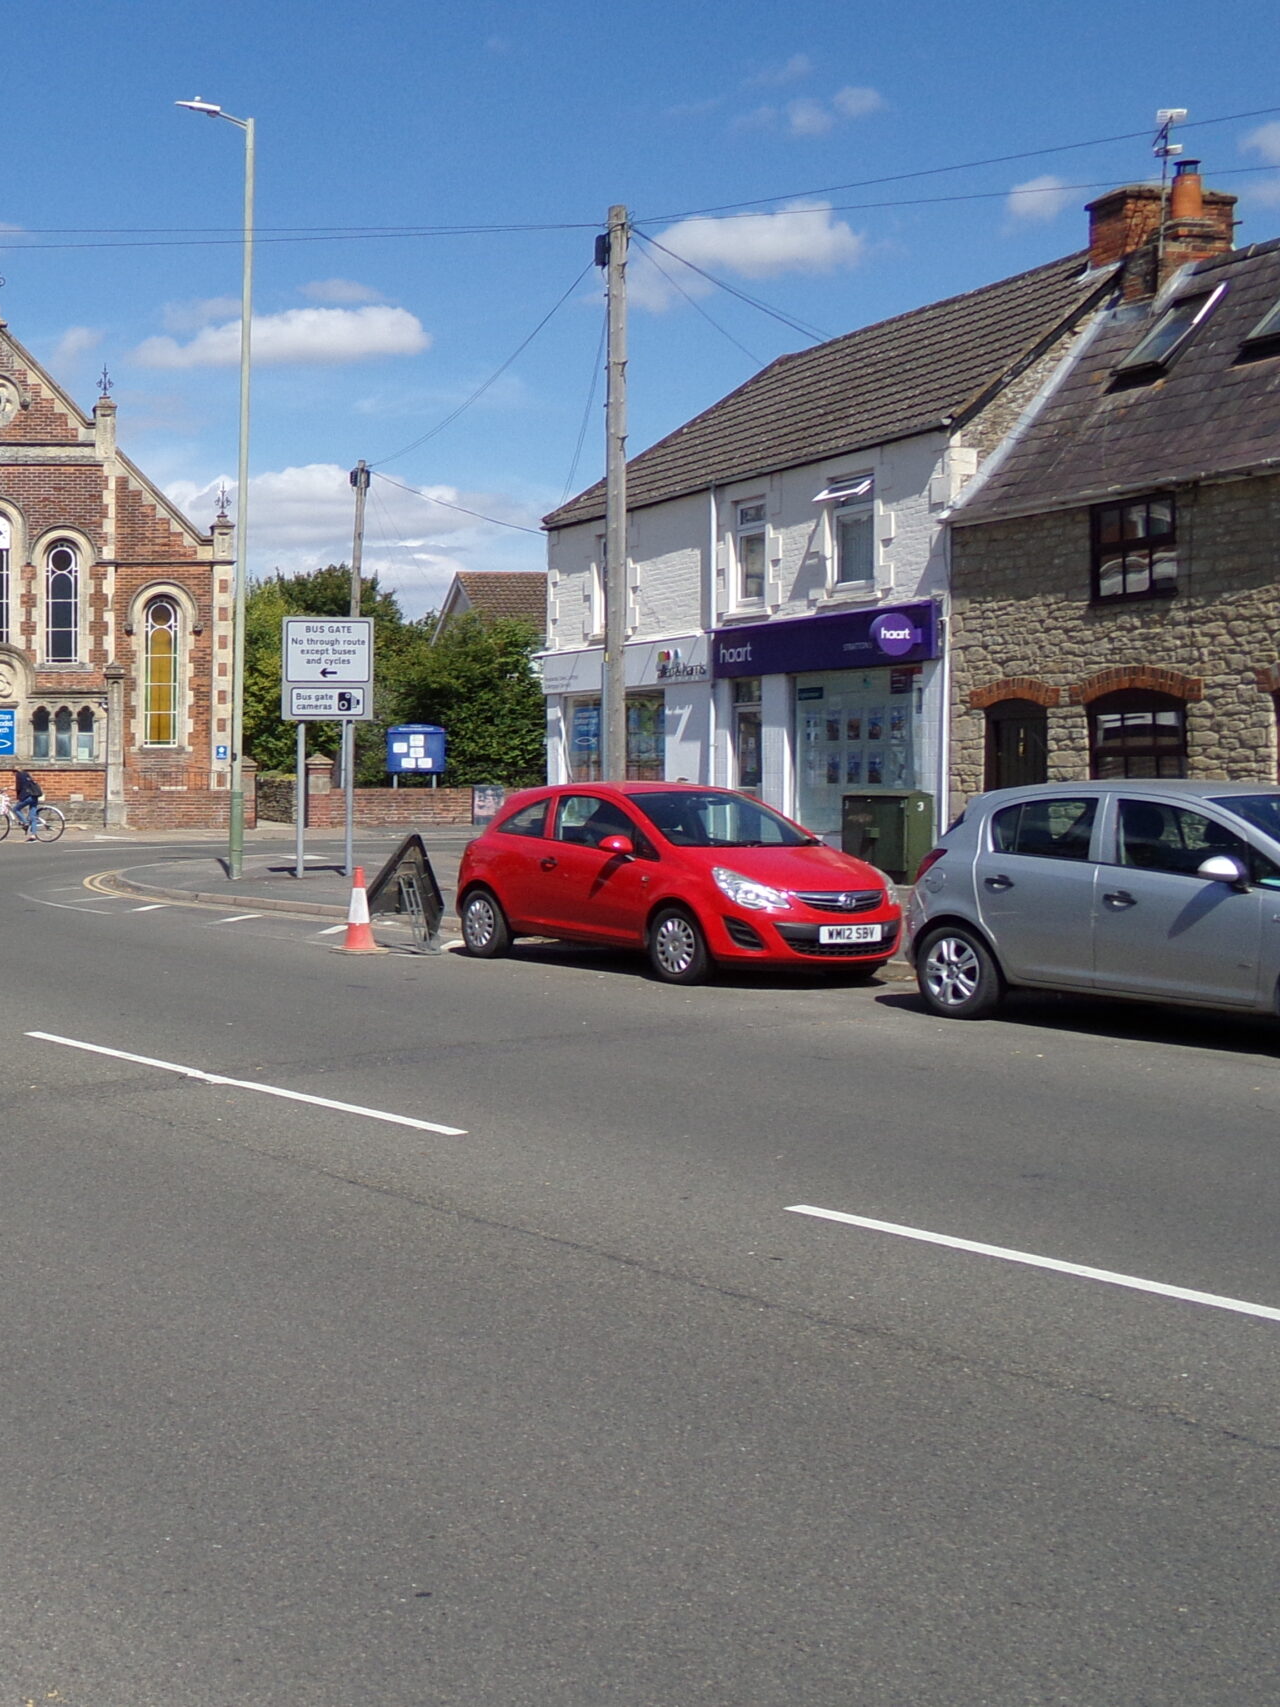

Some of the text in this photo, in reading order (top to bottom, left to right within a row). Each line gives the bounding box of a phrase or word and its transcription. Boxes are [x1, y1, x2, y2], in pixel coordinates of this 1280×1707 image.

[305, 625, 352, 633] BUS GATE
[881, 626, 910, 639] haart
[291, 637, 366, 646] No through route
[300, 648, 329, 656] except
[720, 642, 753, 664] haart
[306, 657, 350, 666] and cycles
[314, 693, 334, 702] gate
[296, 703, 332, 711] cameras
[916, 801, 925, 812] 3
[827, 926, 876, 941] WM12 SBV
